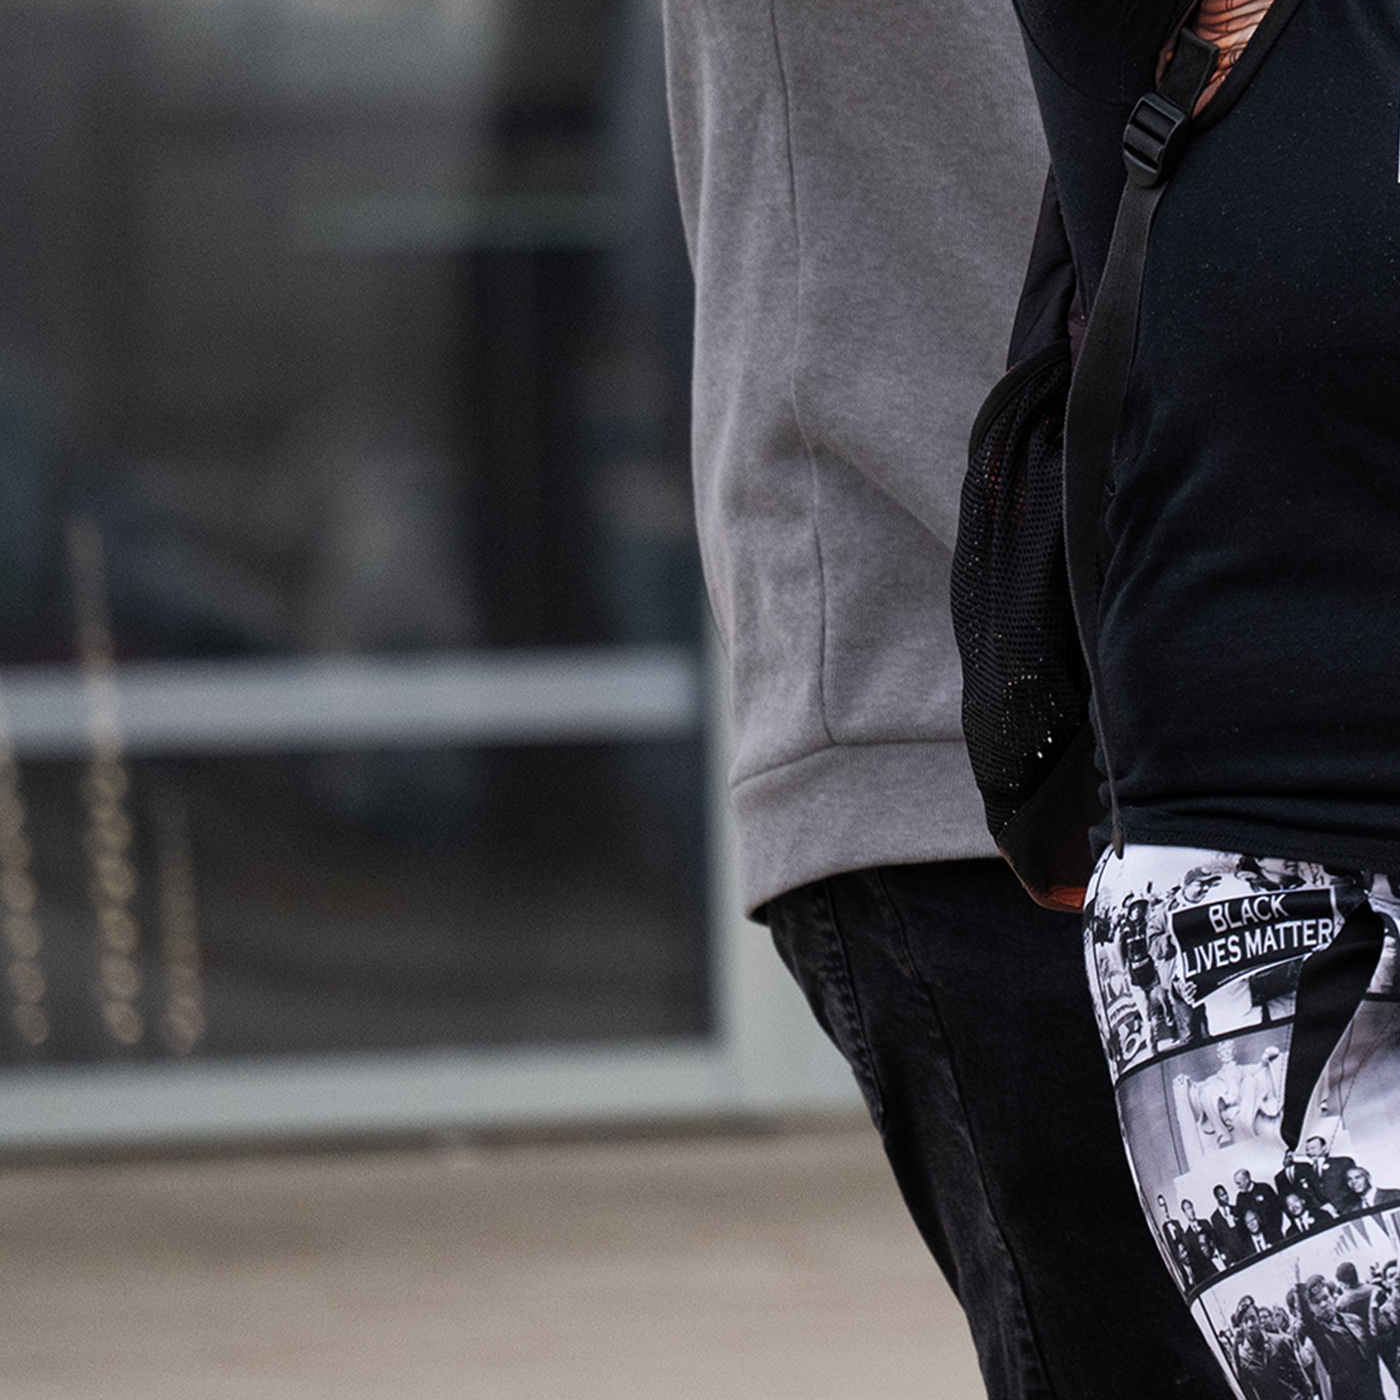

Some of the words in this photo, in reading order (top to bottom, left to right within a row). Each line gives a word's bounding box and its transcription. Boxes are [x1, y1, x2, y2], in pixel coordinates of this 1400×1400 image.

[1208, 893, 1290, 934] BLACK
[1182, 934, 1243, 979] LIVES
[1244, 917, 1335, 959] MATTER
